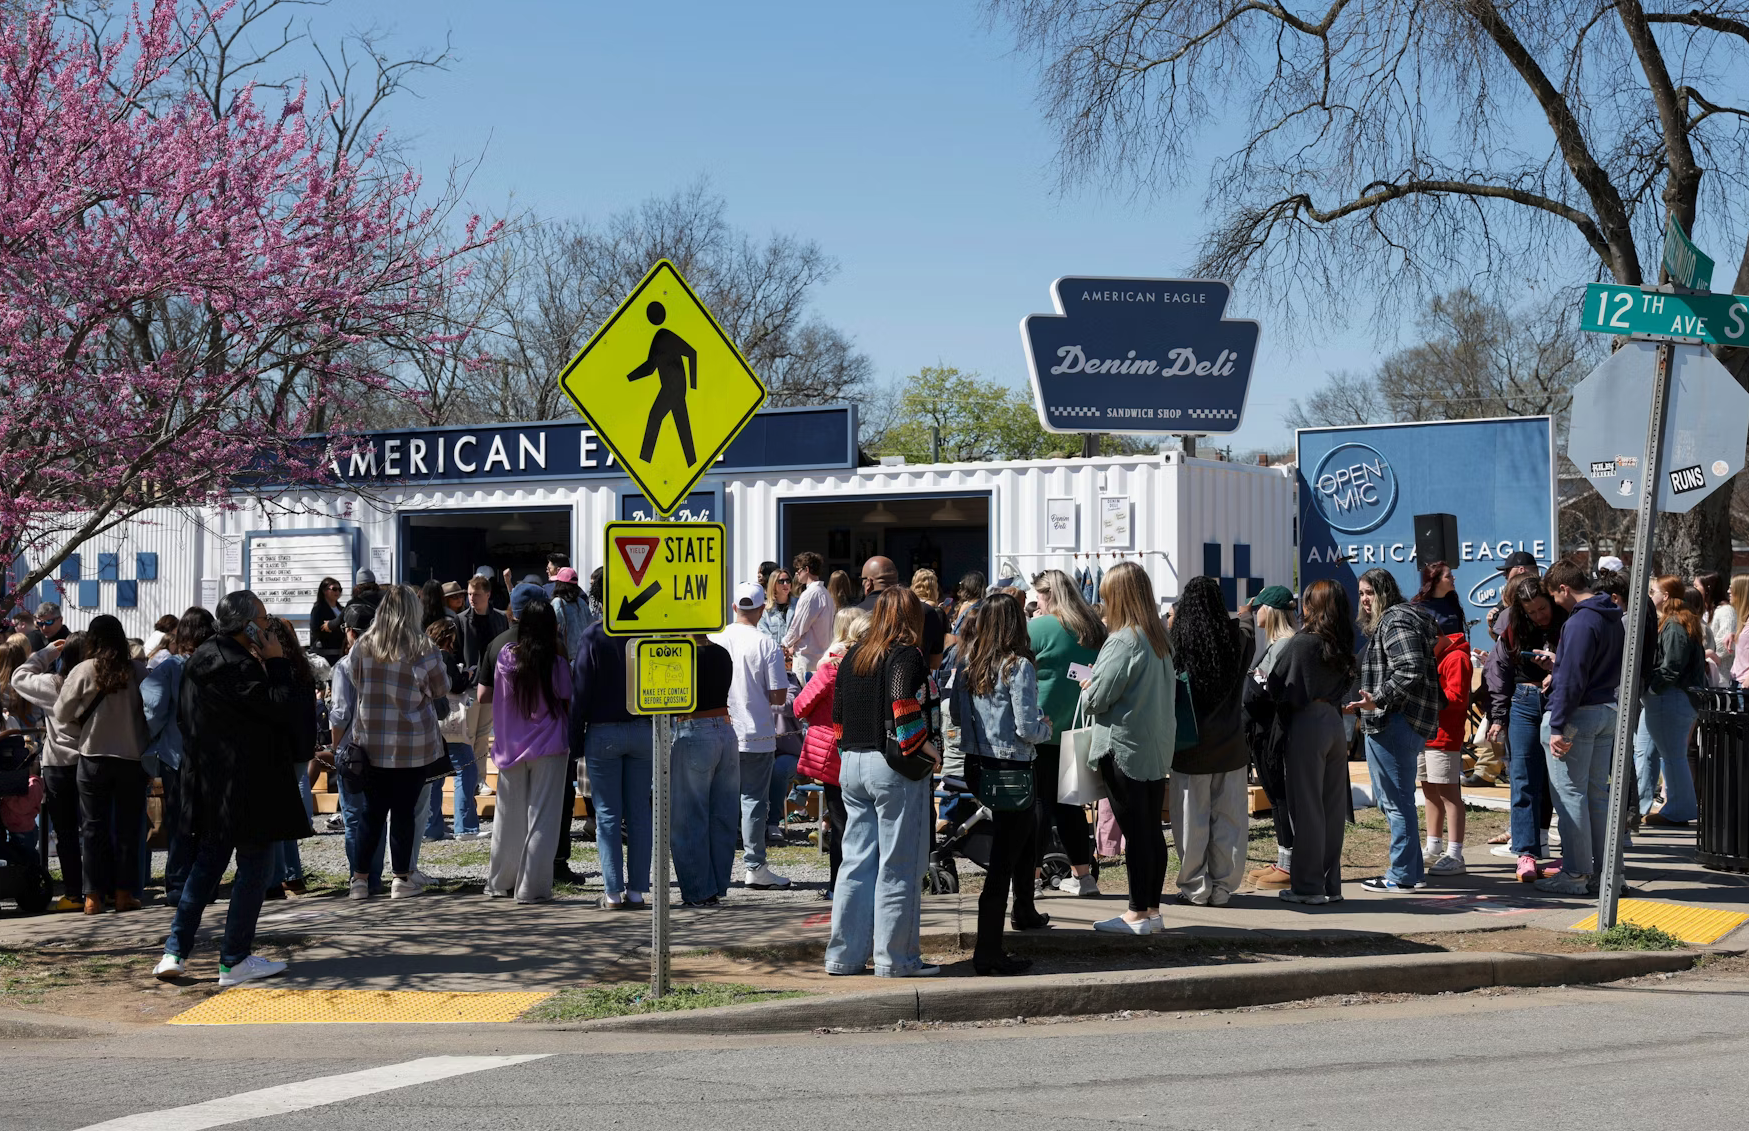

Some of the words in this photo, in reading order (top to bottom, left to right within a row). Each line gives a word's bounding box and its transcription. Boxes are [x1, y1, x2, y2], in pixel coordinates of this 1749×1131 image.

[1082, 291, 1156, 302] AMERICAN
[1164, 293, 1206, 303] EAGLE
[1670, 315, 1708, 336] AVE
[1724, 303, 1748, 339] S
[1051, 345, 1159, 375] Denim
[1162, 347, 1237, 377] Deli
[1107, 408, 1154, 418] SANDWICH
[1157, 408, 1182, 418] SHOP
[320, 431, 546, 478] AMERICAN
[1318, 458, 1382, 493] OPEN
[1671, 467, 1704, 491] RUNS
[1333, 483, 1378, 512] MIC
[664, 536, 715, 563] STATE
[1307, 543, 1418, 563] AMERICA
[674, 574, 708, 600] LAW
[1477, 588, 1495, 603] live
[649, 646, 682, 657] LOOK!
[643, 688, 655, 696] MAKE
[668, 687, 689, 695] CONTACT
[664, 696, 687, 704] CROSSING
